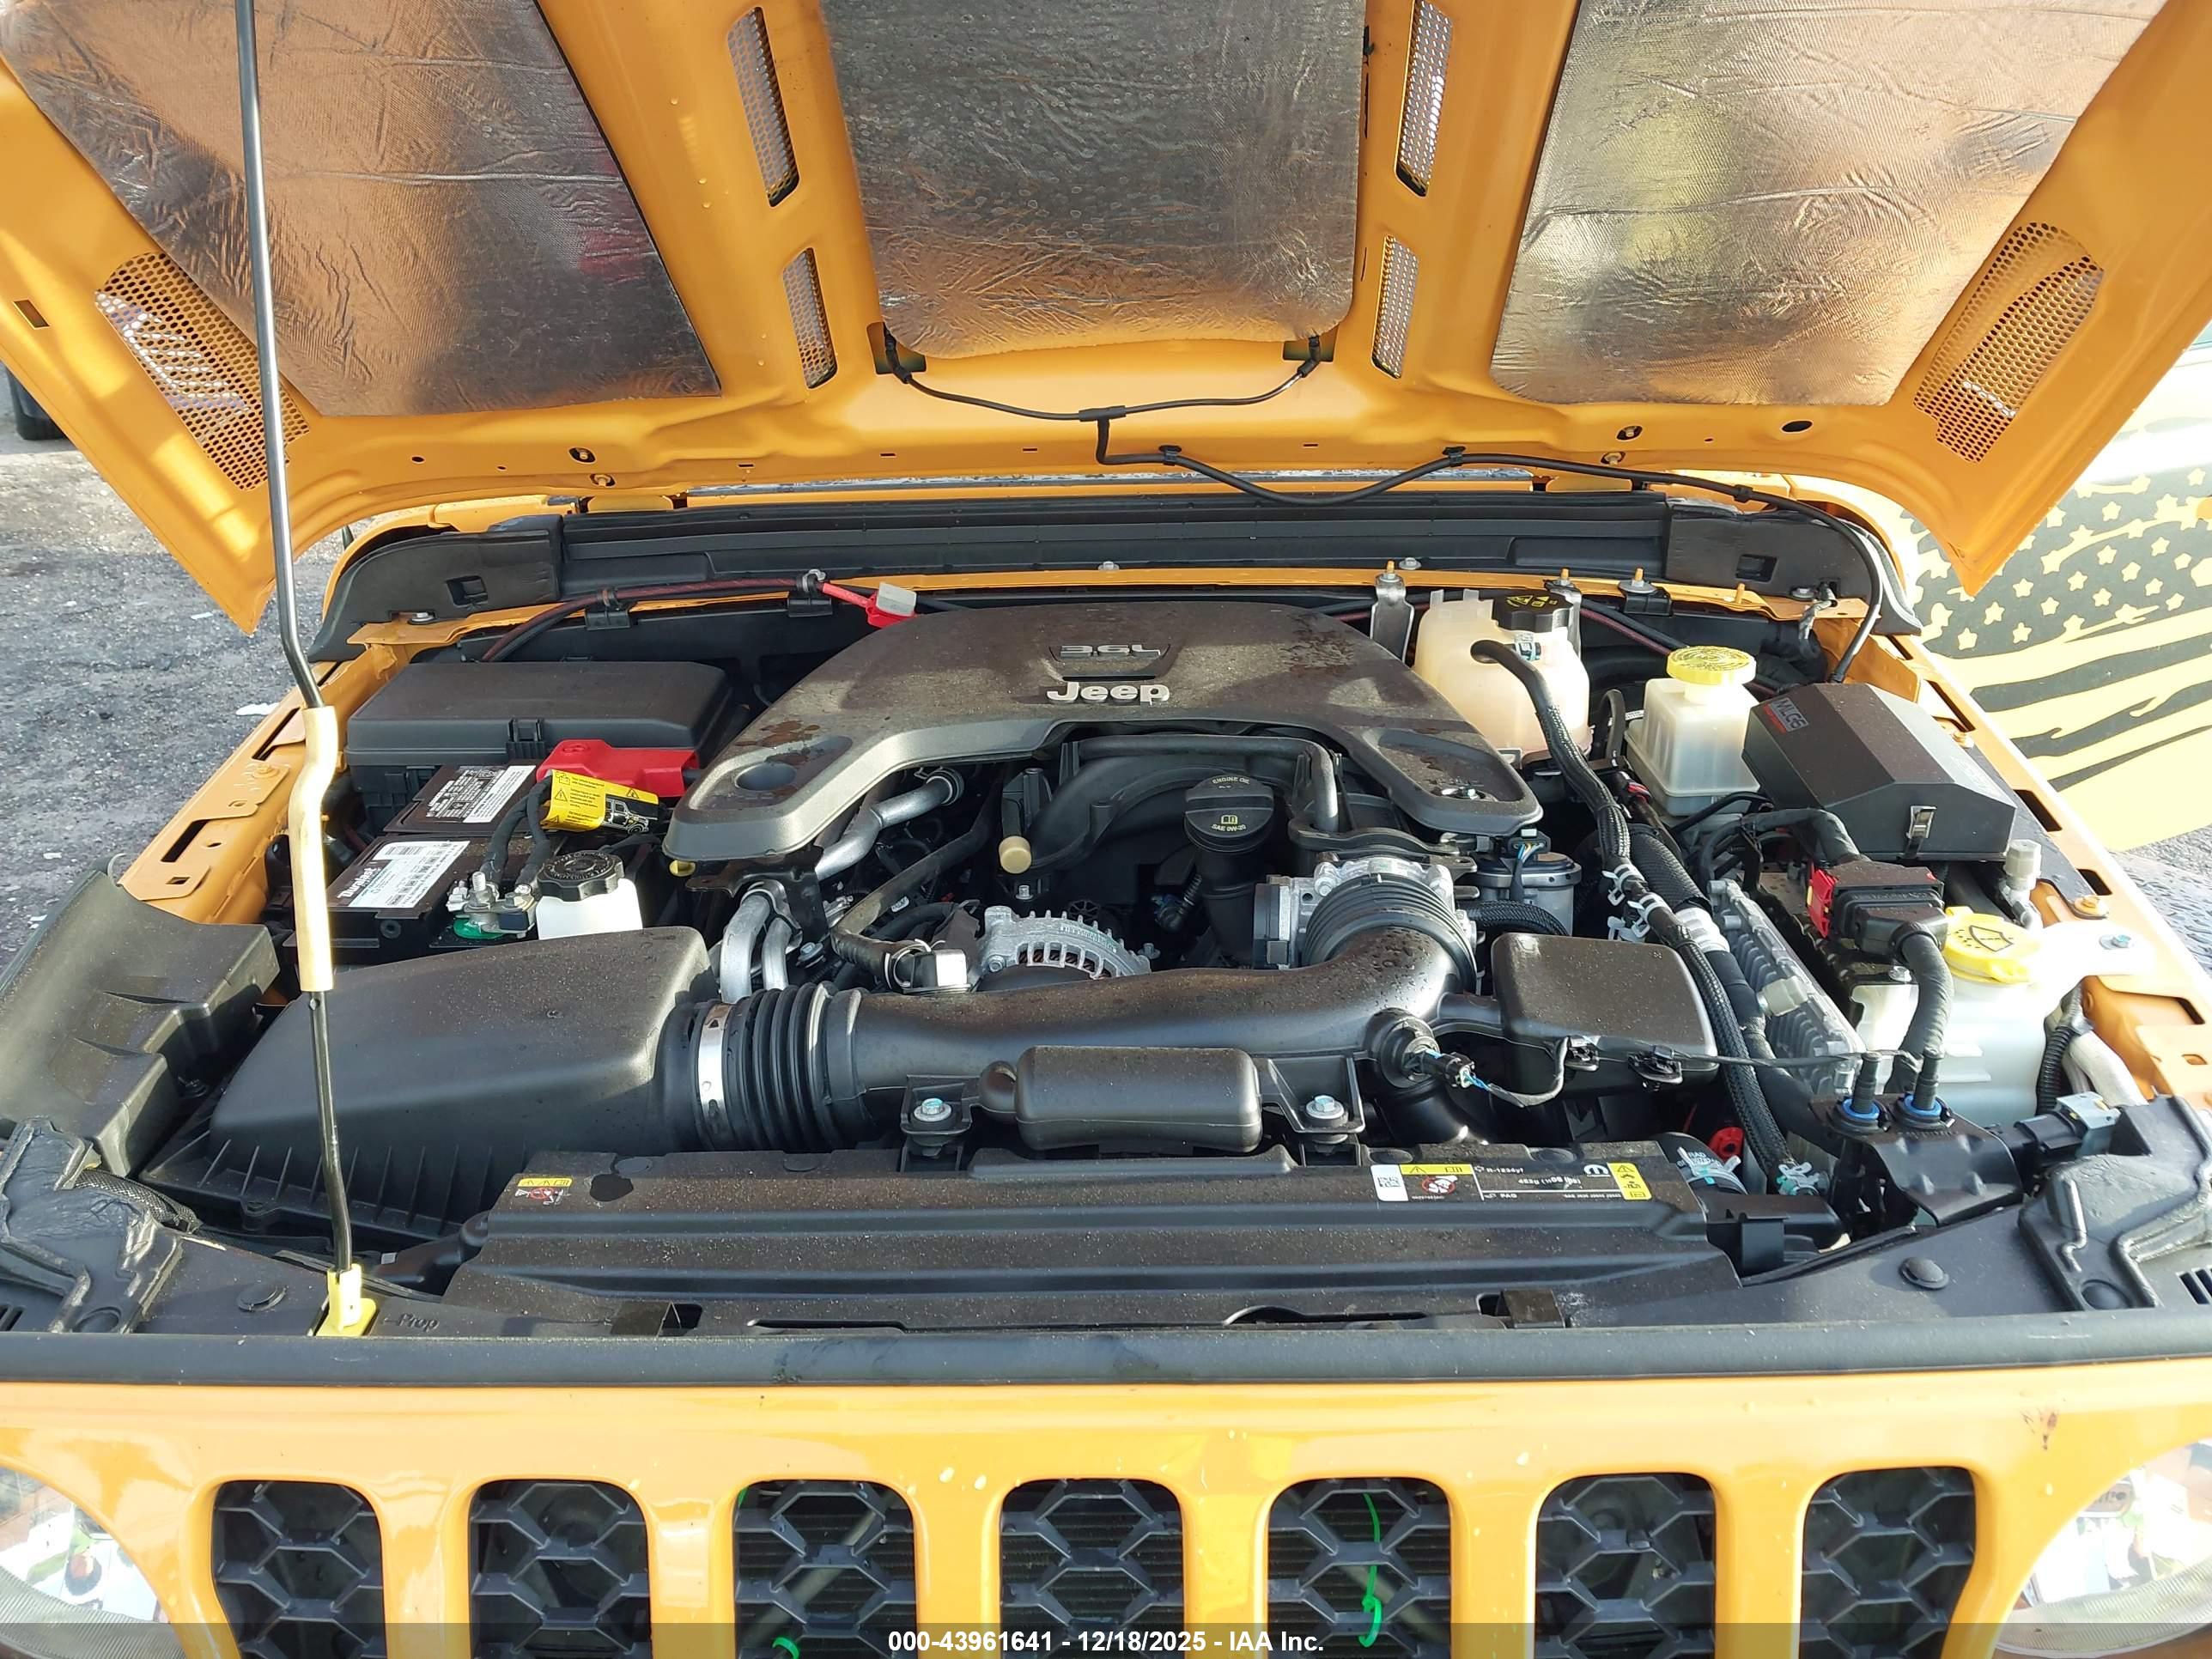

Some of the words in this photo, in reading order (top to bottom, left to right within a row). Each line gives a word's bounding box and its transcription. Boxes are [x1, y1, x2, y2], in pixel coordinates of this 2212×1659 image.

[1047, 682, 1170, 705] Jeep
[337, 867, 377, 899] Duralast
[399, 1312, 440, 1333] Prop
